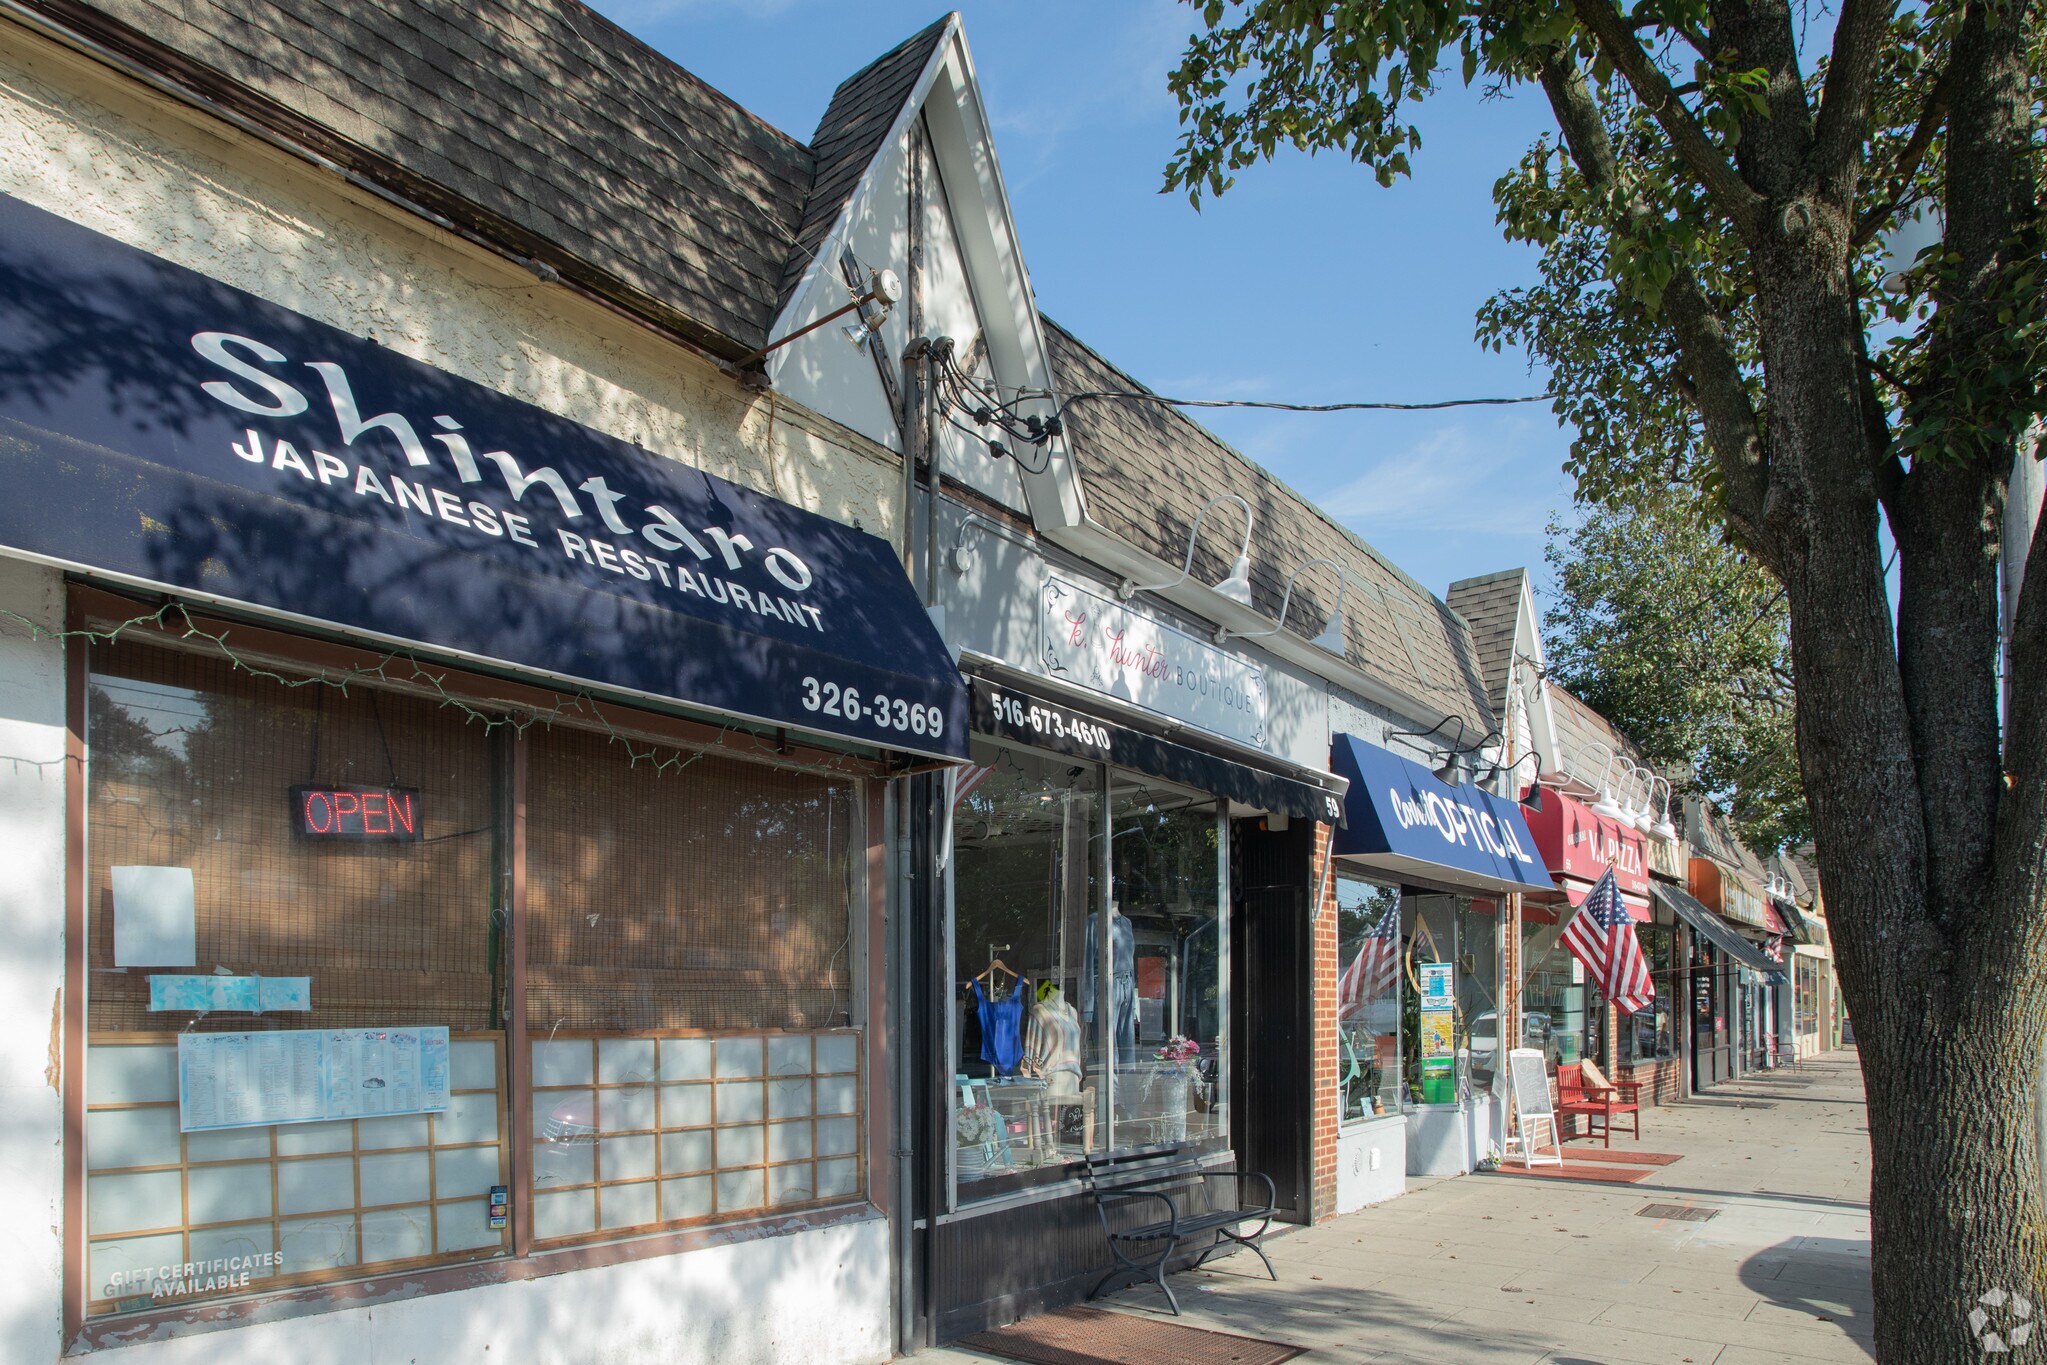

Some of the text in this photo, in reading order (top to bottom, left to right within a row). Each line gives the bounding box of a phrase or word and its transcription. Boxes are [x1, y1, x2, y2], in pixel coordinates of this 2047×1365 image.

[191, 331, 813, 593] Shintaro
[231, 428, 825, 633] JAPANESE RESTAURANT
[800, 675, 944, 739] 326-3369
[1176, 665, 1252, 714] BOUTIQUE
[991, 693, 1111, 750] 516-673-4610
[305, 791, 413, 834] OPEN
[1325, 796, 1340, 818] 59
[1427, 791, 1533, 863] OPTICAL
[111, 1251, 284, 1287] GIFT CERTIFICATES
[151, 1271, 250, 1299] AVAILABLE
